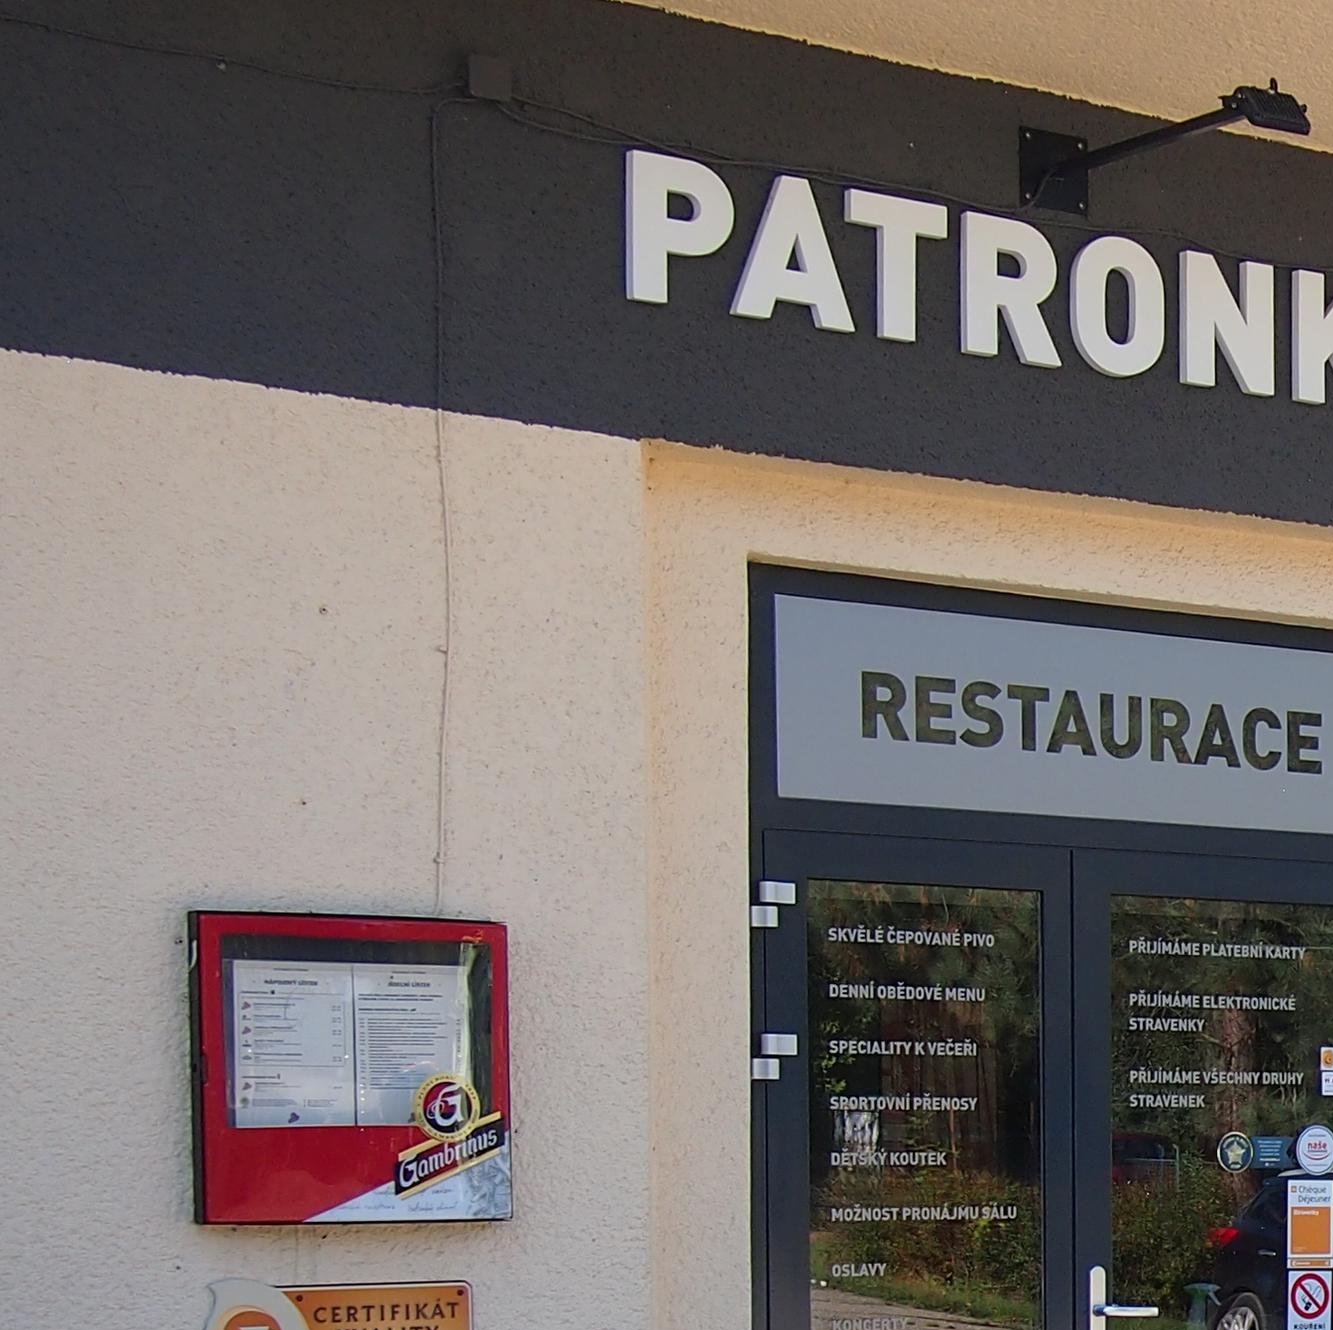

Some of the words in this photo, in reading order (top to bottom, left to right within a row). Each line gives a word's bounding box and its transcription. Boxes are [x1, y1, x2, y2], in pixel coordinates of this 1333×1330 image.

[860, 670, 1323, 775] RESTAURACE
[827, 927, 884, 944] SKVĚLÉ
[886, 926, 960, 946] ČEPOVANÉ
[963, 933, 995, 948] PIVO
[1129, 938, 1200, 957] PŘIJÍMÁME
[1203, 940, 1263, 959] PLATEBNÍ
[1266, 946, 1306, 961] KARTY
[829, 980, 874, 999] DENNÍ
[877, 981, 943, 1000] OBĚDOVÉ
[947, 986, 985, 1001] MENU
[1129, 992, 1200, 1010] PŘIJÍMÁME
[1202, 993, 1297, 1011] ELEKTRONICKÉ
[1129, 1017, 1205, 1033] STRAVENKY
[829, 1040, 911, 1056] SPECIALITY
[914, 1041, 924, 1056] K
[927, 1039, 978, 1057] VEČEŘI
[1129, 1068, 1200, 1086] PŘIJÍMÁME
[1203, 1067, 1261, 1086] VŠECHNY
[1263, 1071, 1304, 1086] DRUHY
[829, 1093, 911, 1111] SPORTOVNÍ
[914, 1093, 978, 1112] PŘENOSY
[1129, 1093, 1205, 1109] STRAVENEK
[399, 1129, 498, 1188] Gambrinus
[889, 1151, 947, 1166] KOUTEK
[831, 1203, 899, 1222] MOŽNOST
[902, 1202, 979, 1222] PRONÁJMU
[982, 1200, 1018, 1221] SÁLU
[831, 1262, 887, 1278] OSLAVY
[313, 1298, 462, 1324] CERTIFIKÁT
